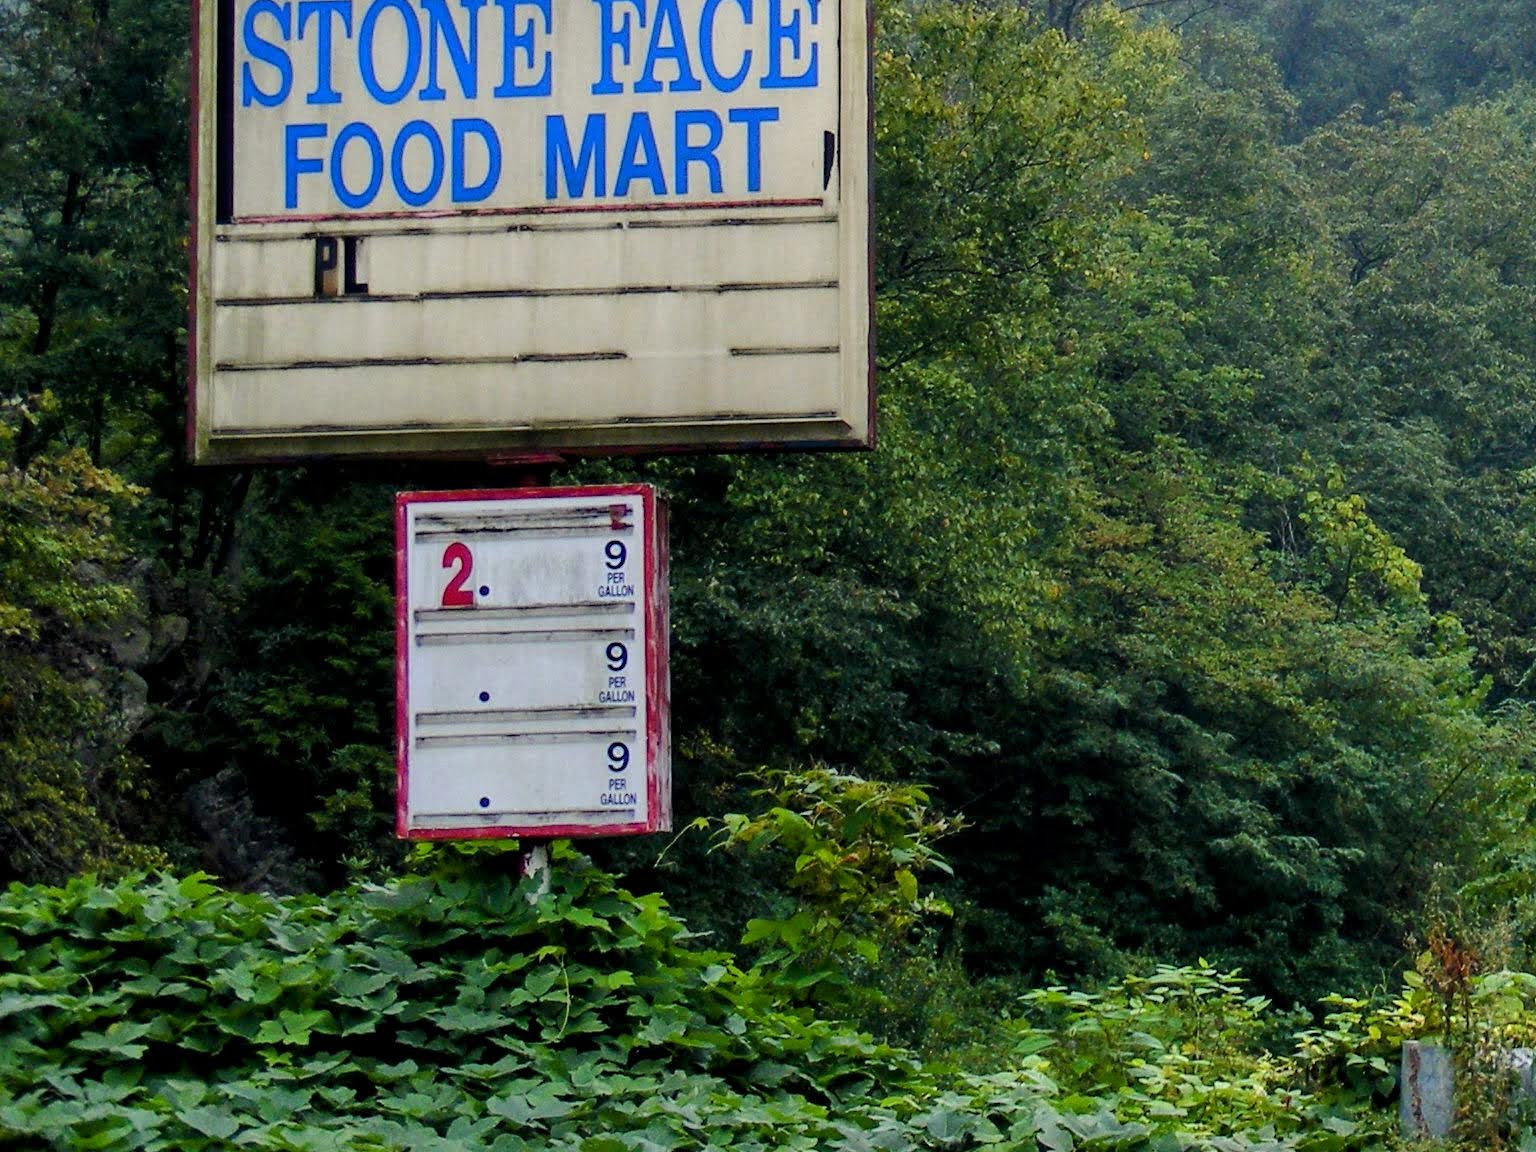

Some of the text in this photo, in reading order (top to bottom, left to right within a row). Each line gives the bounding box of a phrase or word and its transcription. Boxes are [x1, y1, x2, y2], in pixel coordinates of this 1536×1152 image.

[284, 107, 780, 209] FOOD MART
[605, 540, 627, 570] 9
[607, 572, 625, 584] PER
[598, 585, 634, 597] GALLON
[605, 641, 628, 672] 9
[608, 676, 626, 689] PER
[599, 690, 635, 703] GALLON
[607, 741, 630, 773] 9
[609, 778, 627, 791] PER
[600, 793, 637, 806] GALLON
